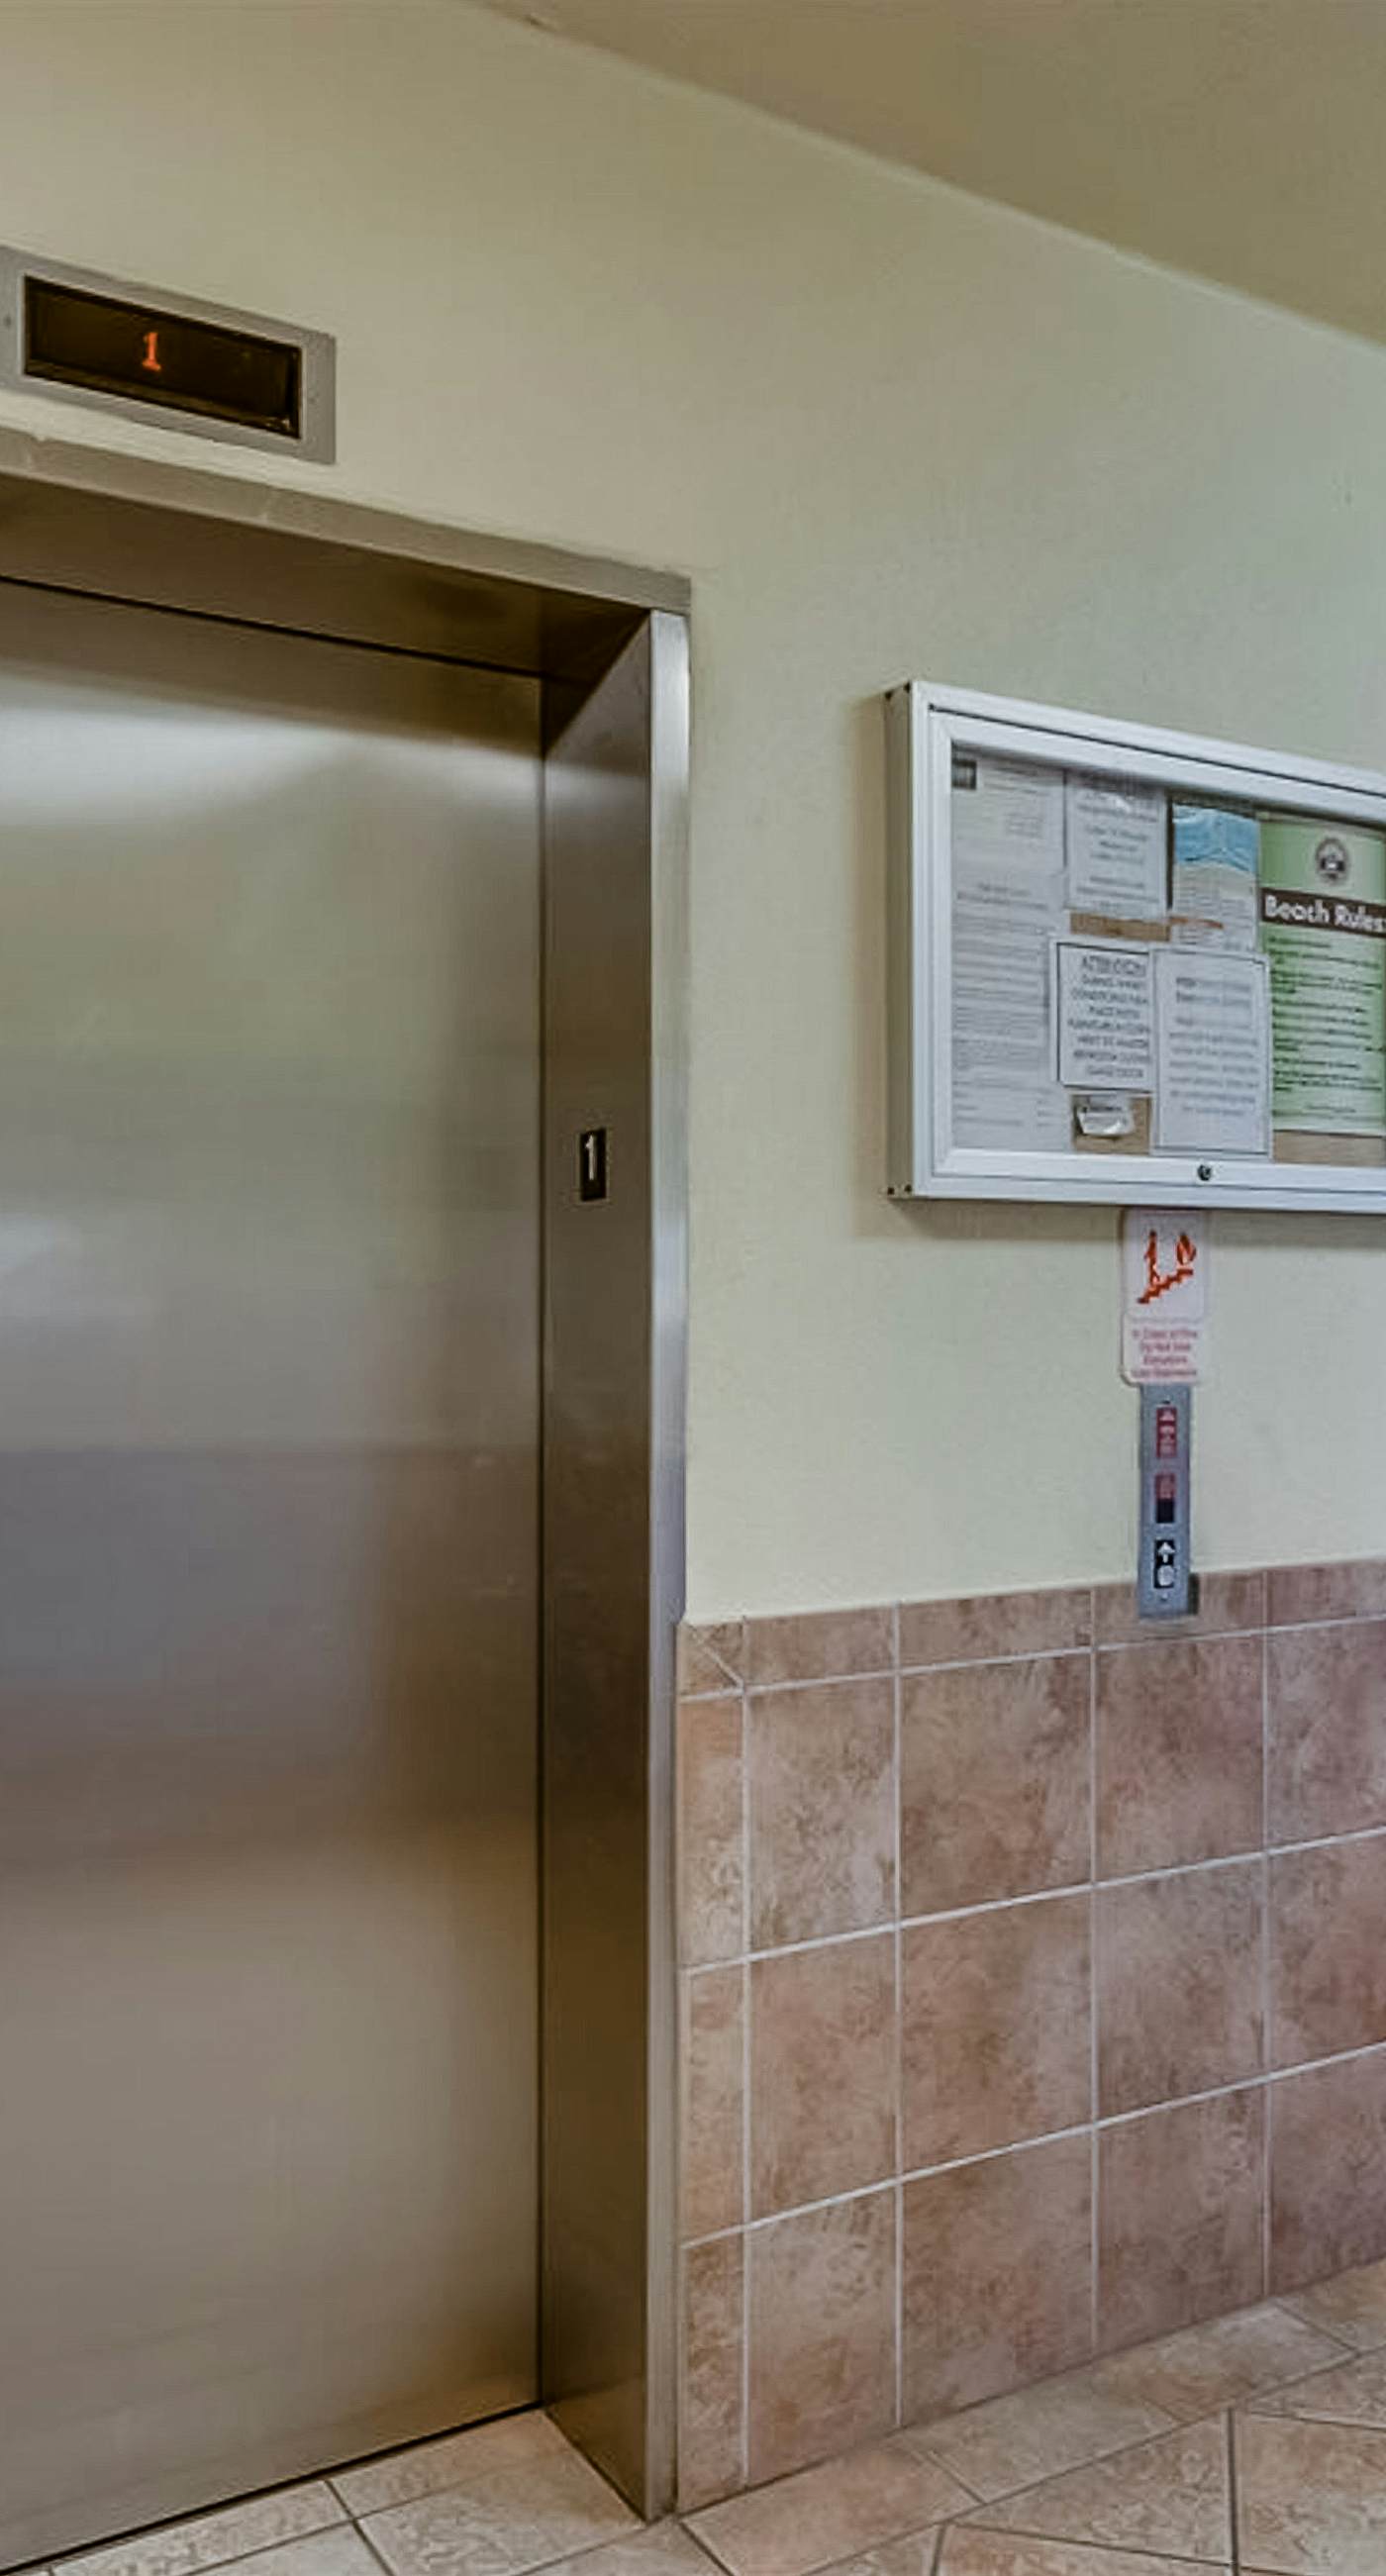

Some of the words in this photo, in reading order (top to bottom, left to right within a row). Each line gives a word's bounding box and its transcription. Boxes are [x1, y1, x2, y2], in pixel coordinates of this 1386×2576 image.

[142, 332, 162, 372] 1
[1264, 894, 1330, 924] Beach
[584, 1134, 595, 1181] 1
